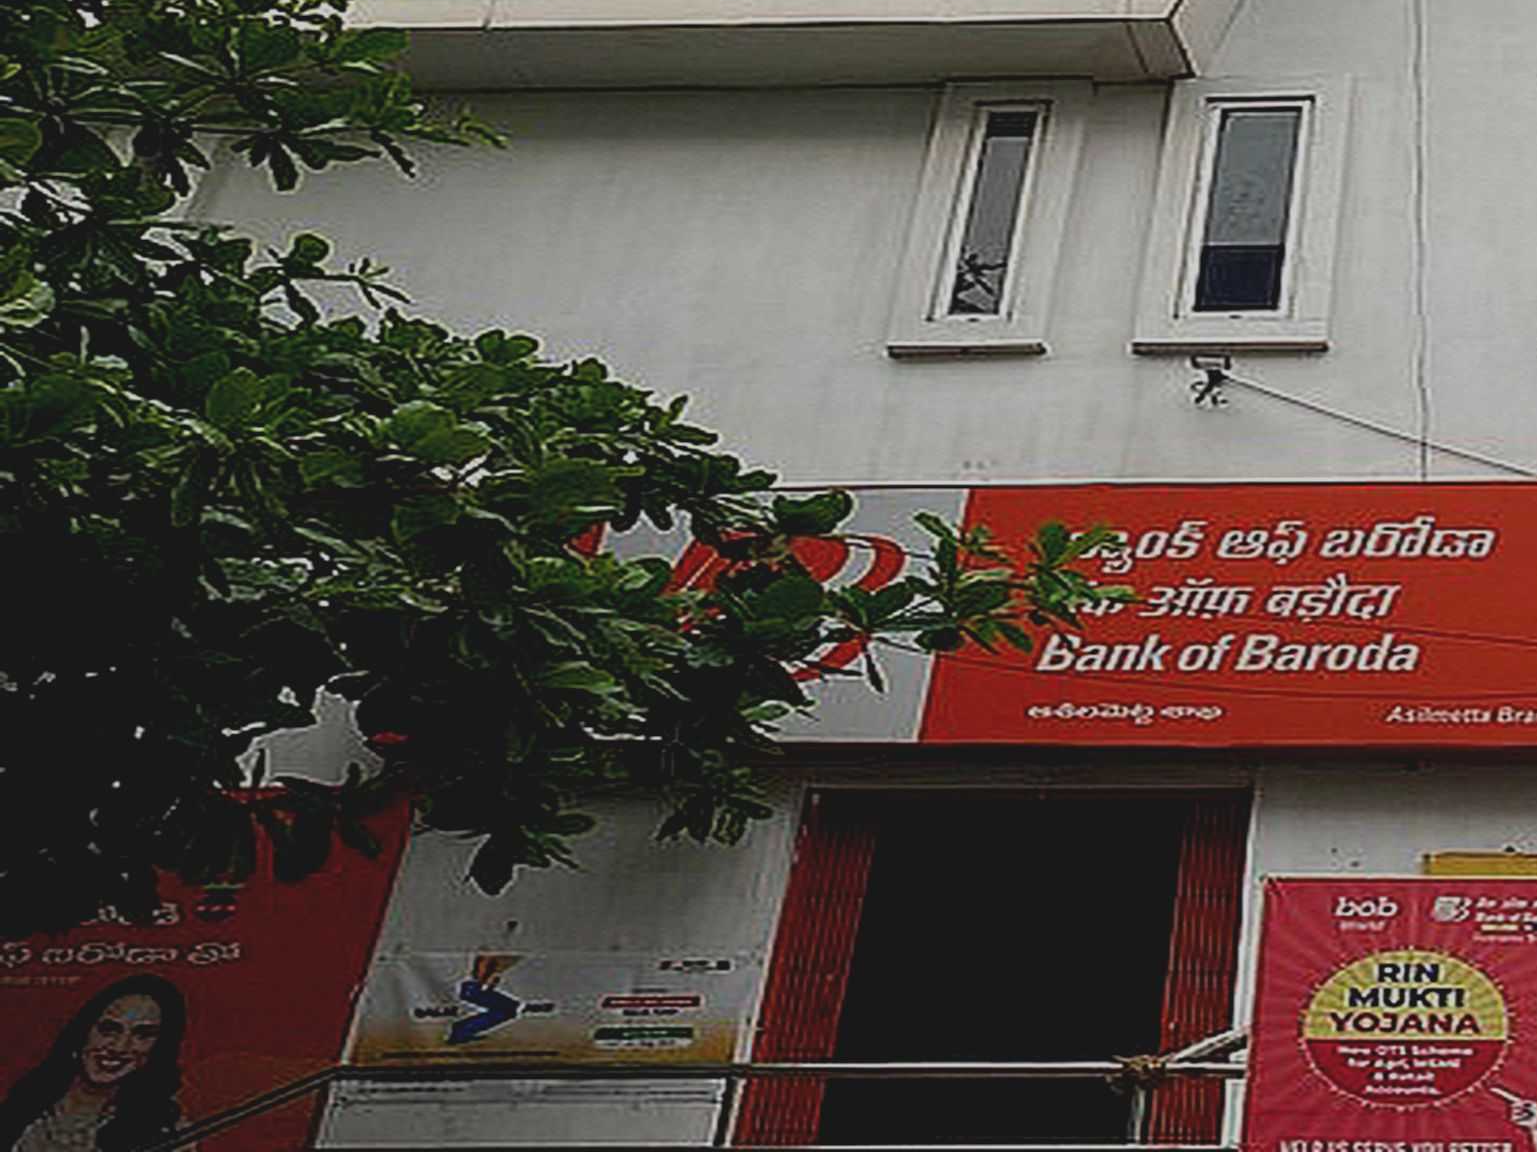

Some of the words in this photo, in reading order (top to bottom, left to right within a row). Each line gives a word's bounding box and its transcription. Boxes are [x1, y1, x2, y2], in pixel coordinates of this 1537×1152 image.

[1318, 515, 1497, 560] బరోడా
[1266, 572, 1402, 623] बड़ौदा
[1035, 634, 1171, 672] Bank
[1177, 634, 1237, 672] of
[1235, 634, 1419, 672] Baroda
[1335, 896, 1399, 918] bob
[1377, 963, 1440, 983] RIN
[1349, 988, 1466, 1008] MUKTI
[1330, 1012, 1481, 1033] YOJANA
